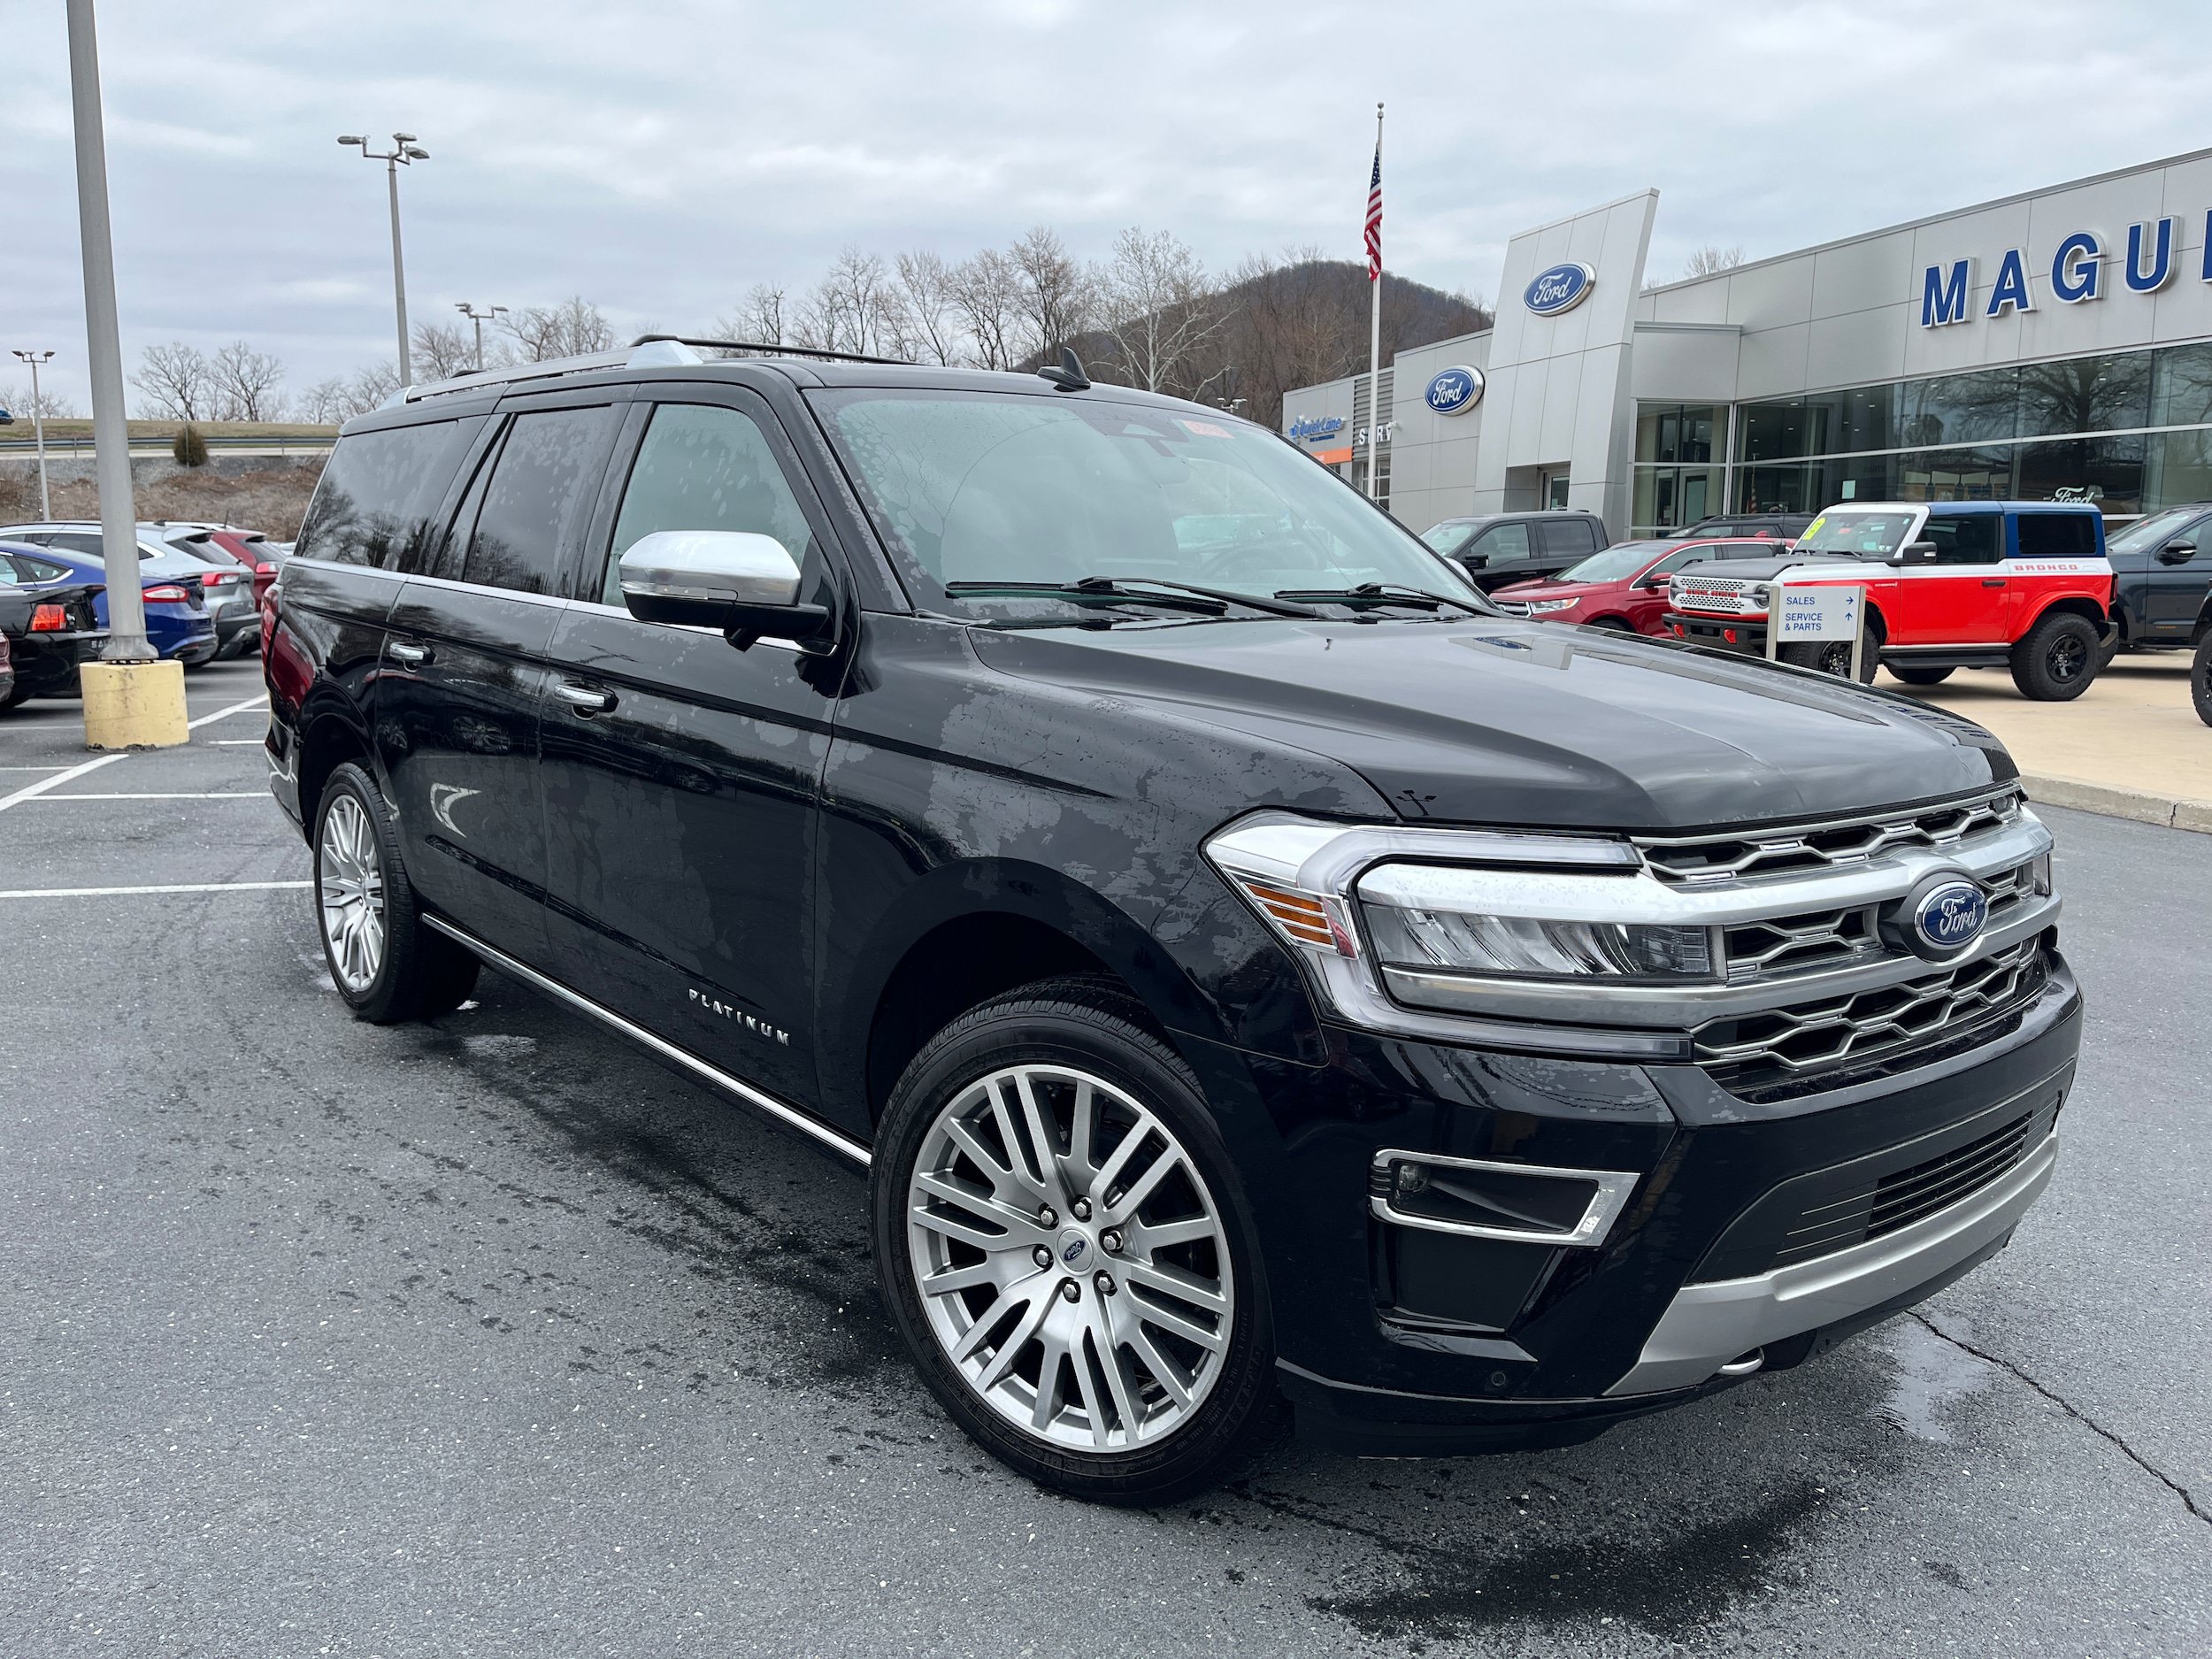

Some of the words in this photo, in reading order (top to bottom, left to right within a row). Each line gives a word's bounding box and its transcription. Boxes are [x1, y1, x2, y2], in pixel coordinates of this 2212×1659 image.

[1533, 273, 1572, 305] Ford
[1432, 376, 1463, 406] Ford
[1358, 425, 1392, 445] SRV
[1786, 596, 1816, 605] SALES
[1785, 612, 1823, 621] SERVICE
[1939, 895, 1978, 936] Ford
[688, 988, 790, 1047] PLATINUM
